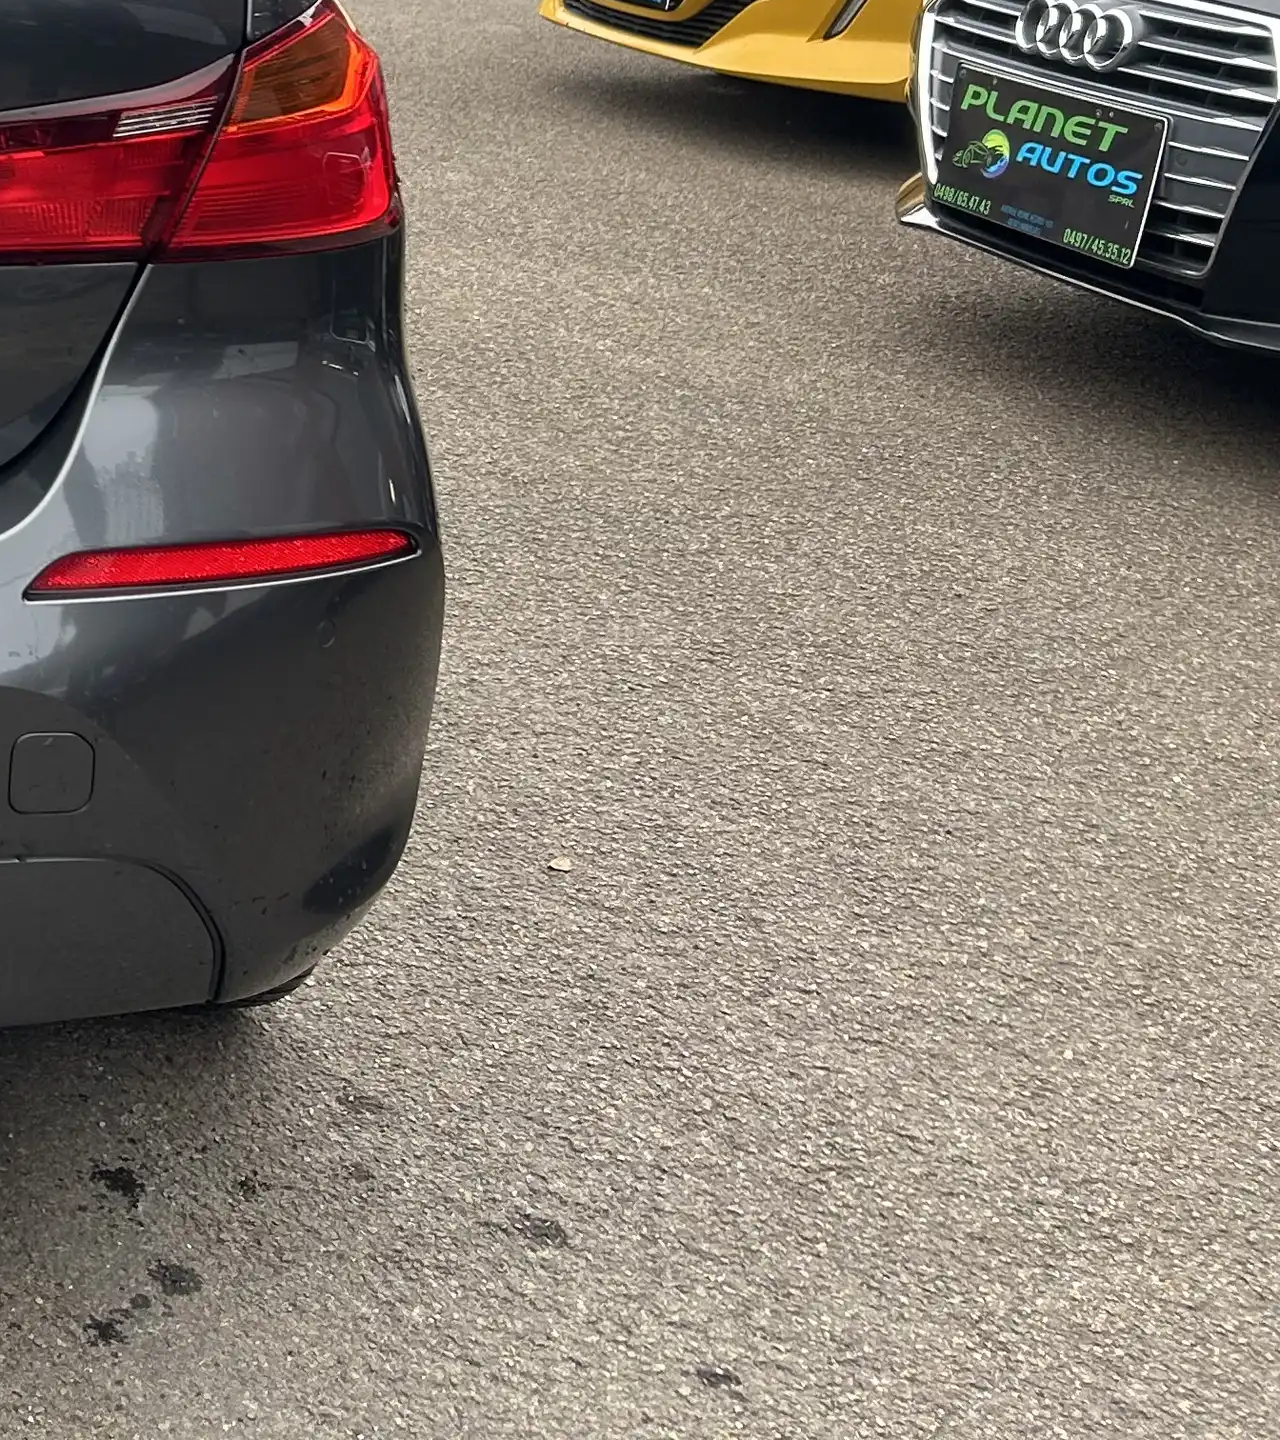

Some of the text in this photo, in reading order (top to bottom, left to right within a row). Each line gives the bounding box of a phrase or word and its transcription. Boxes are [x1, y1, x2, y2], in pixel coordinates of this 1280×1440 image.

[960, 84, 1129, 152] PLANET
[1016, 141, 1143, 196] AUTOS
[1063, 228, 1131, 265] 0497/45.35.12
